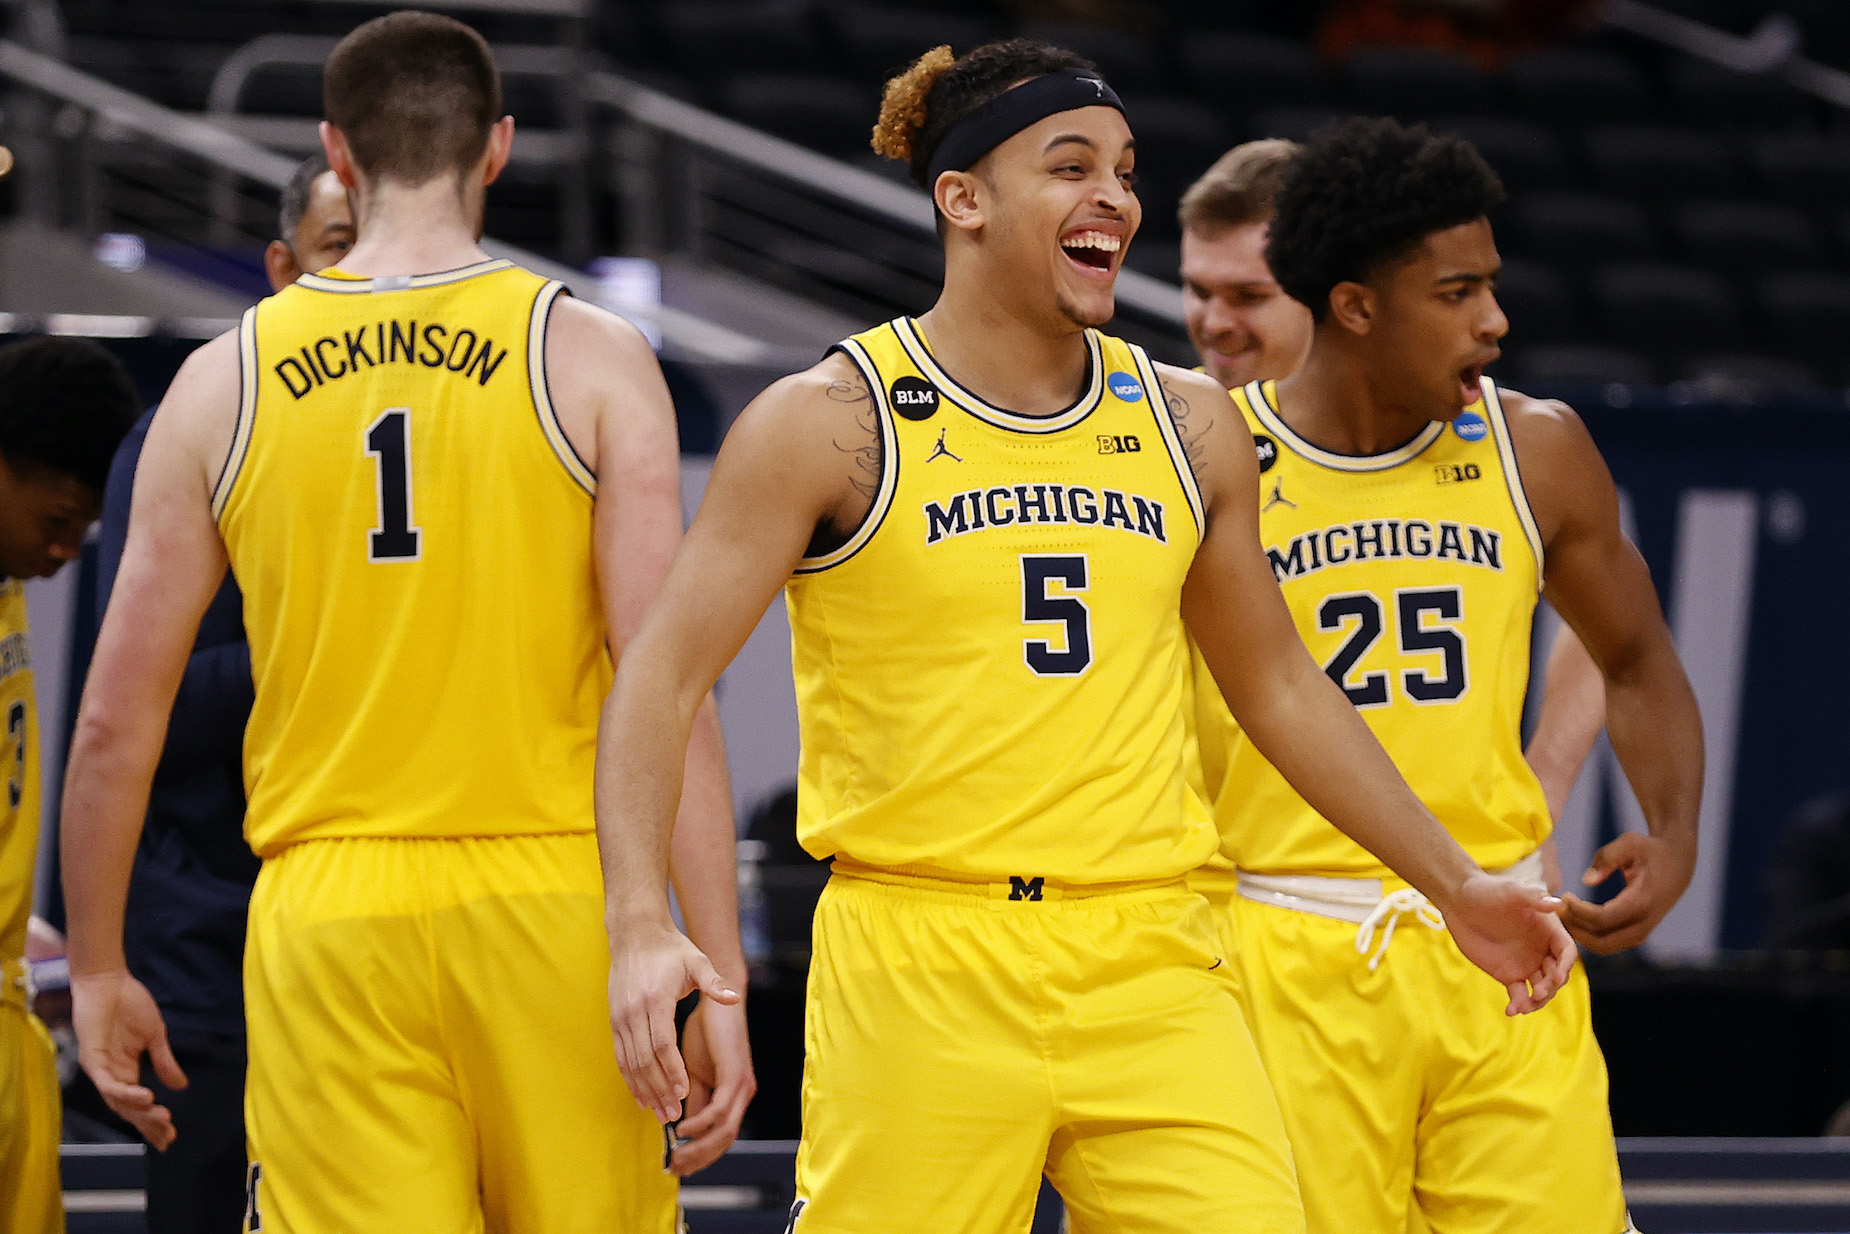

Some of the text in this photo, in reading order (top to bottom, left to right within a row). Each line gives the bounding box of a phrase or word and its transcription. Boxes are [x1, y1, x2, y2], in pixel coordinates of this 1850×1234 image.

[275, 319, 508, 400] DICKINSON
[1114, 384, 1142, 396] NCAA
[895, 390, 935, 405] BLM
[364, 407, 422, 564] 1
[923, 483, 1168, 545] MICHIGAN
[1265, 518, 1503, 583] MICHIGAN
[1019, 553, 1094, 677] 5
[1316, 585, 1469, 709] 25
[1008, 876, 1045, 901] M
